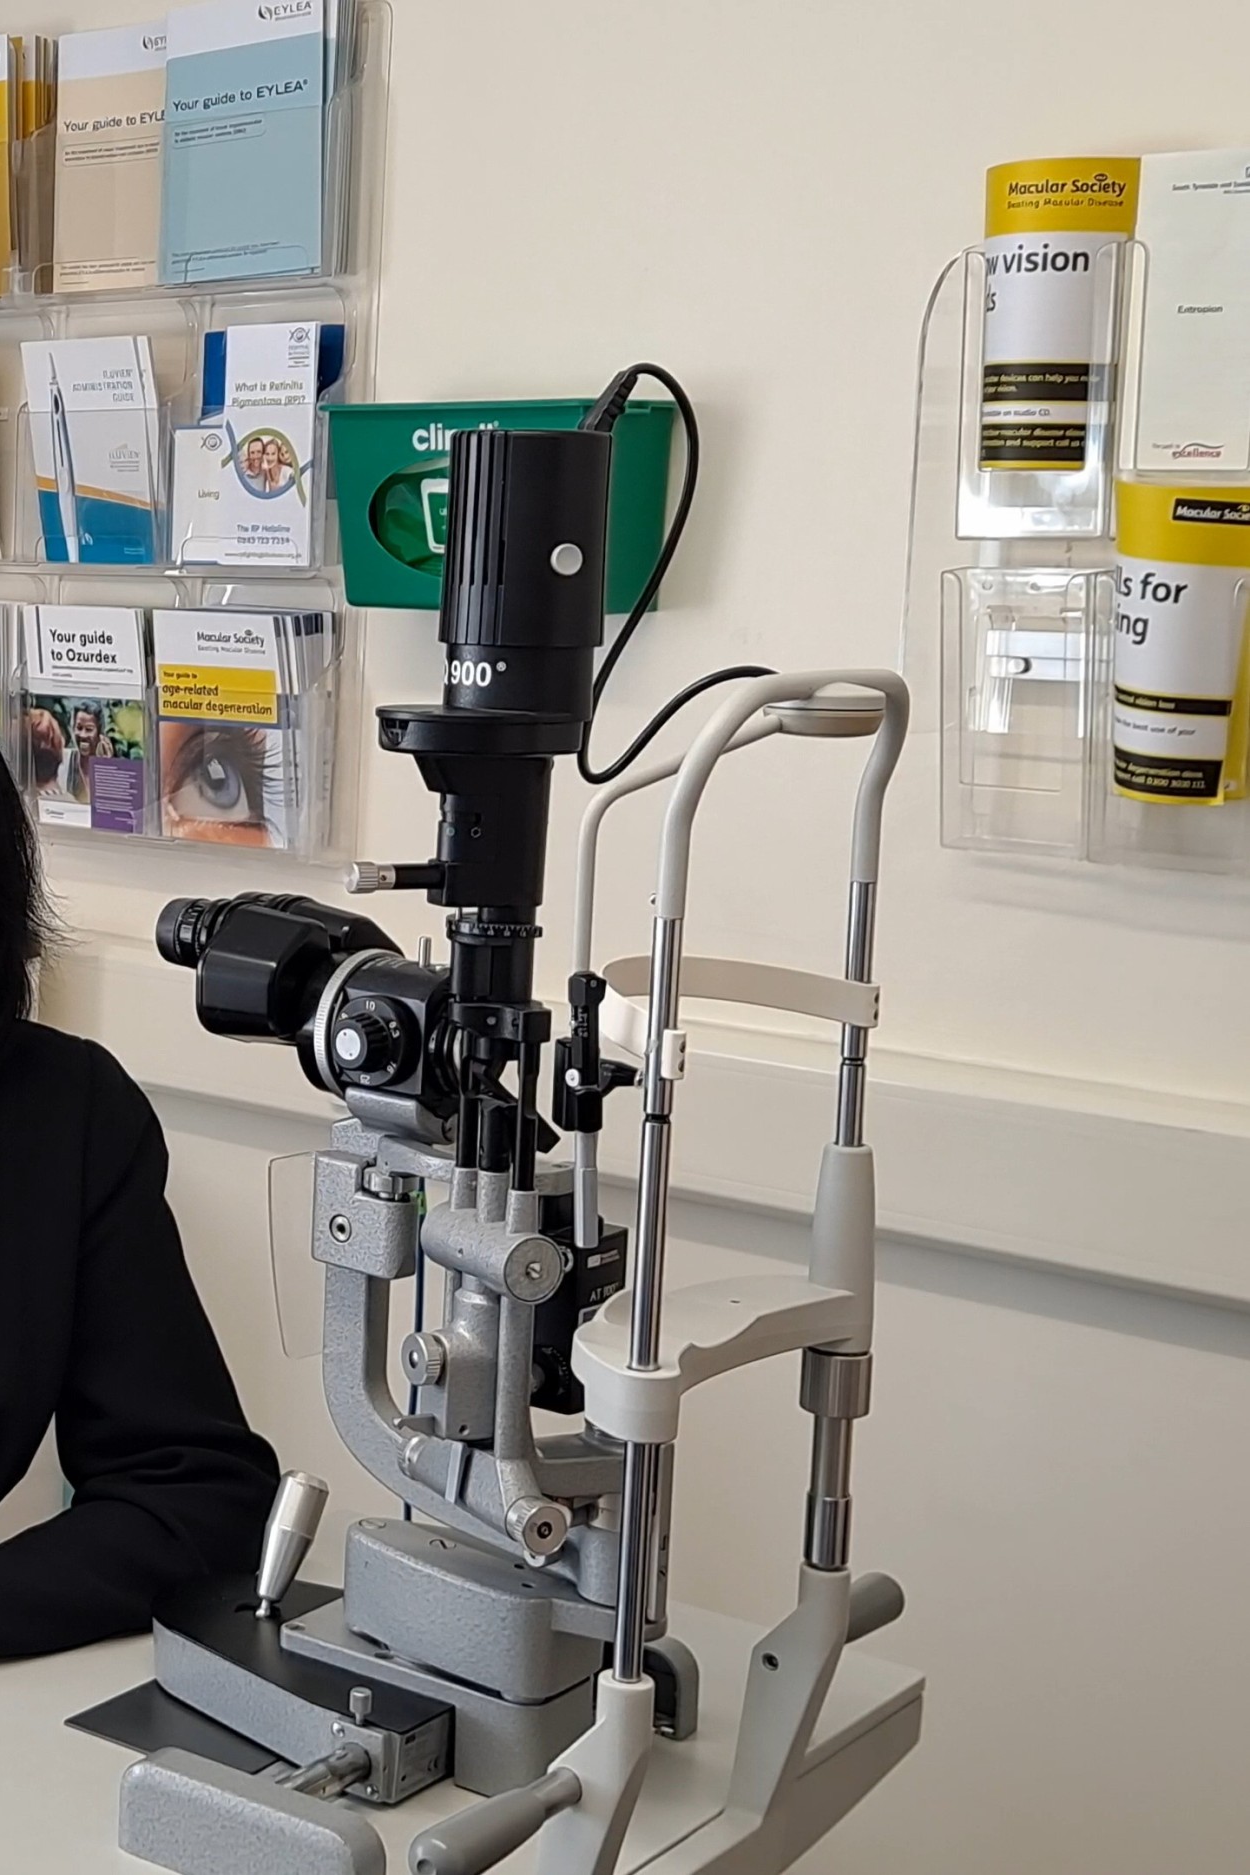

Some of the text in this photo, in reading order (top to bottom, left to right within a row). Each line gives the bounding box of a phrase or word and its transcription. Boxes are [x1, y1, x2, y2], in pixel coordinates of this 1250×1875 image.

[274, 1, 312, 16] EYLEA
[173, 100, 199, 112] Your
[203, 92, 236, 110] guide
[240, 90, 252, 101] to
[64, 121, 89, 132] Your
[92, 116, 123, 131] guide
[126, 116, 136, 126] to
[1008, 178, 1126, 198] Macular Society
[1007, 198, 1124, 209] Beating Macular Disease
[1002, 243, 1090, 274] vision
[235, 380, 303, 393] What is Retinitis
[197, 489, 220, 501] Living
[1175, 505, 1222, 519] Macular
[1140, 572, 1188, 604] for
[49, 628, 113, 647] Your guide
[196, 631, 265, 648] Macular Society
[51, 648, 117, 664] to Ozurdex
[162, 683, 219, 697] age-related
[163, 698, 272, 716] macular degeneration
[365, 1000, 376, 1011] 10
